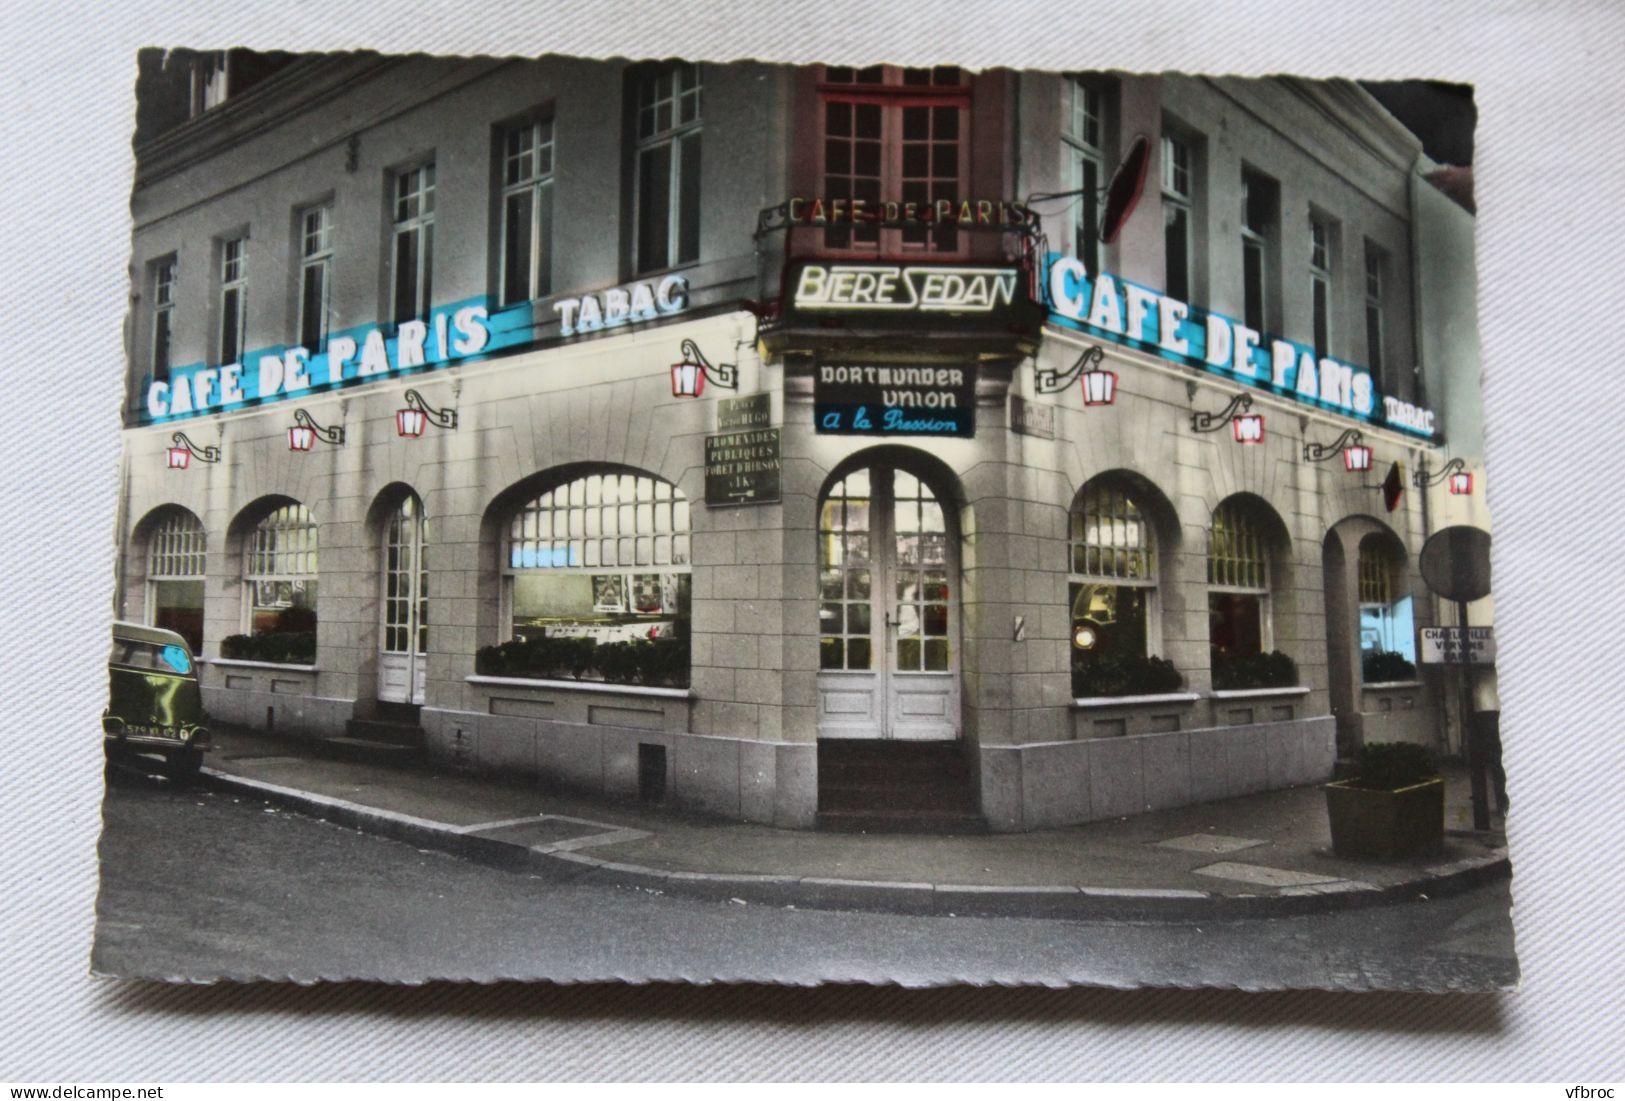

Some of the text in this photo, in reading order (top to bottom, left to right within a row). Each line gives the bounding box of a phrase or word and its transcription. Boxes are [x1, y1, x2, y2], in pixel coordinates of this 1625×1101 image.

[789, 198, 1026, 224] CAFE DE PARIS
[901, 267, 1017, 310] SEDAN
[147, 274, 689, 417] CAFE DE PARIS TABAC
[1049, 256, 1435, 433] CAFE DE PARIS TABAC
[821, 366, 963, 386] DORTMUNDER
[882, 390, 957, 408] UNION
[853, 406, 872, 430] la
[883, 408, 957, 431] Pression
[707, 431, 778, 448] PROMENADES
[711, 447, 774, 462] PUBLIQUES
